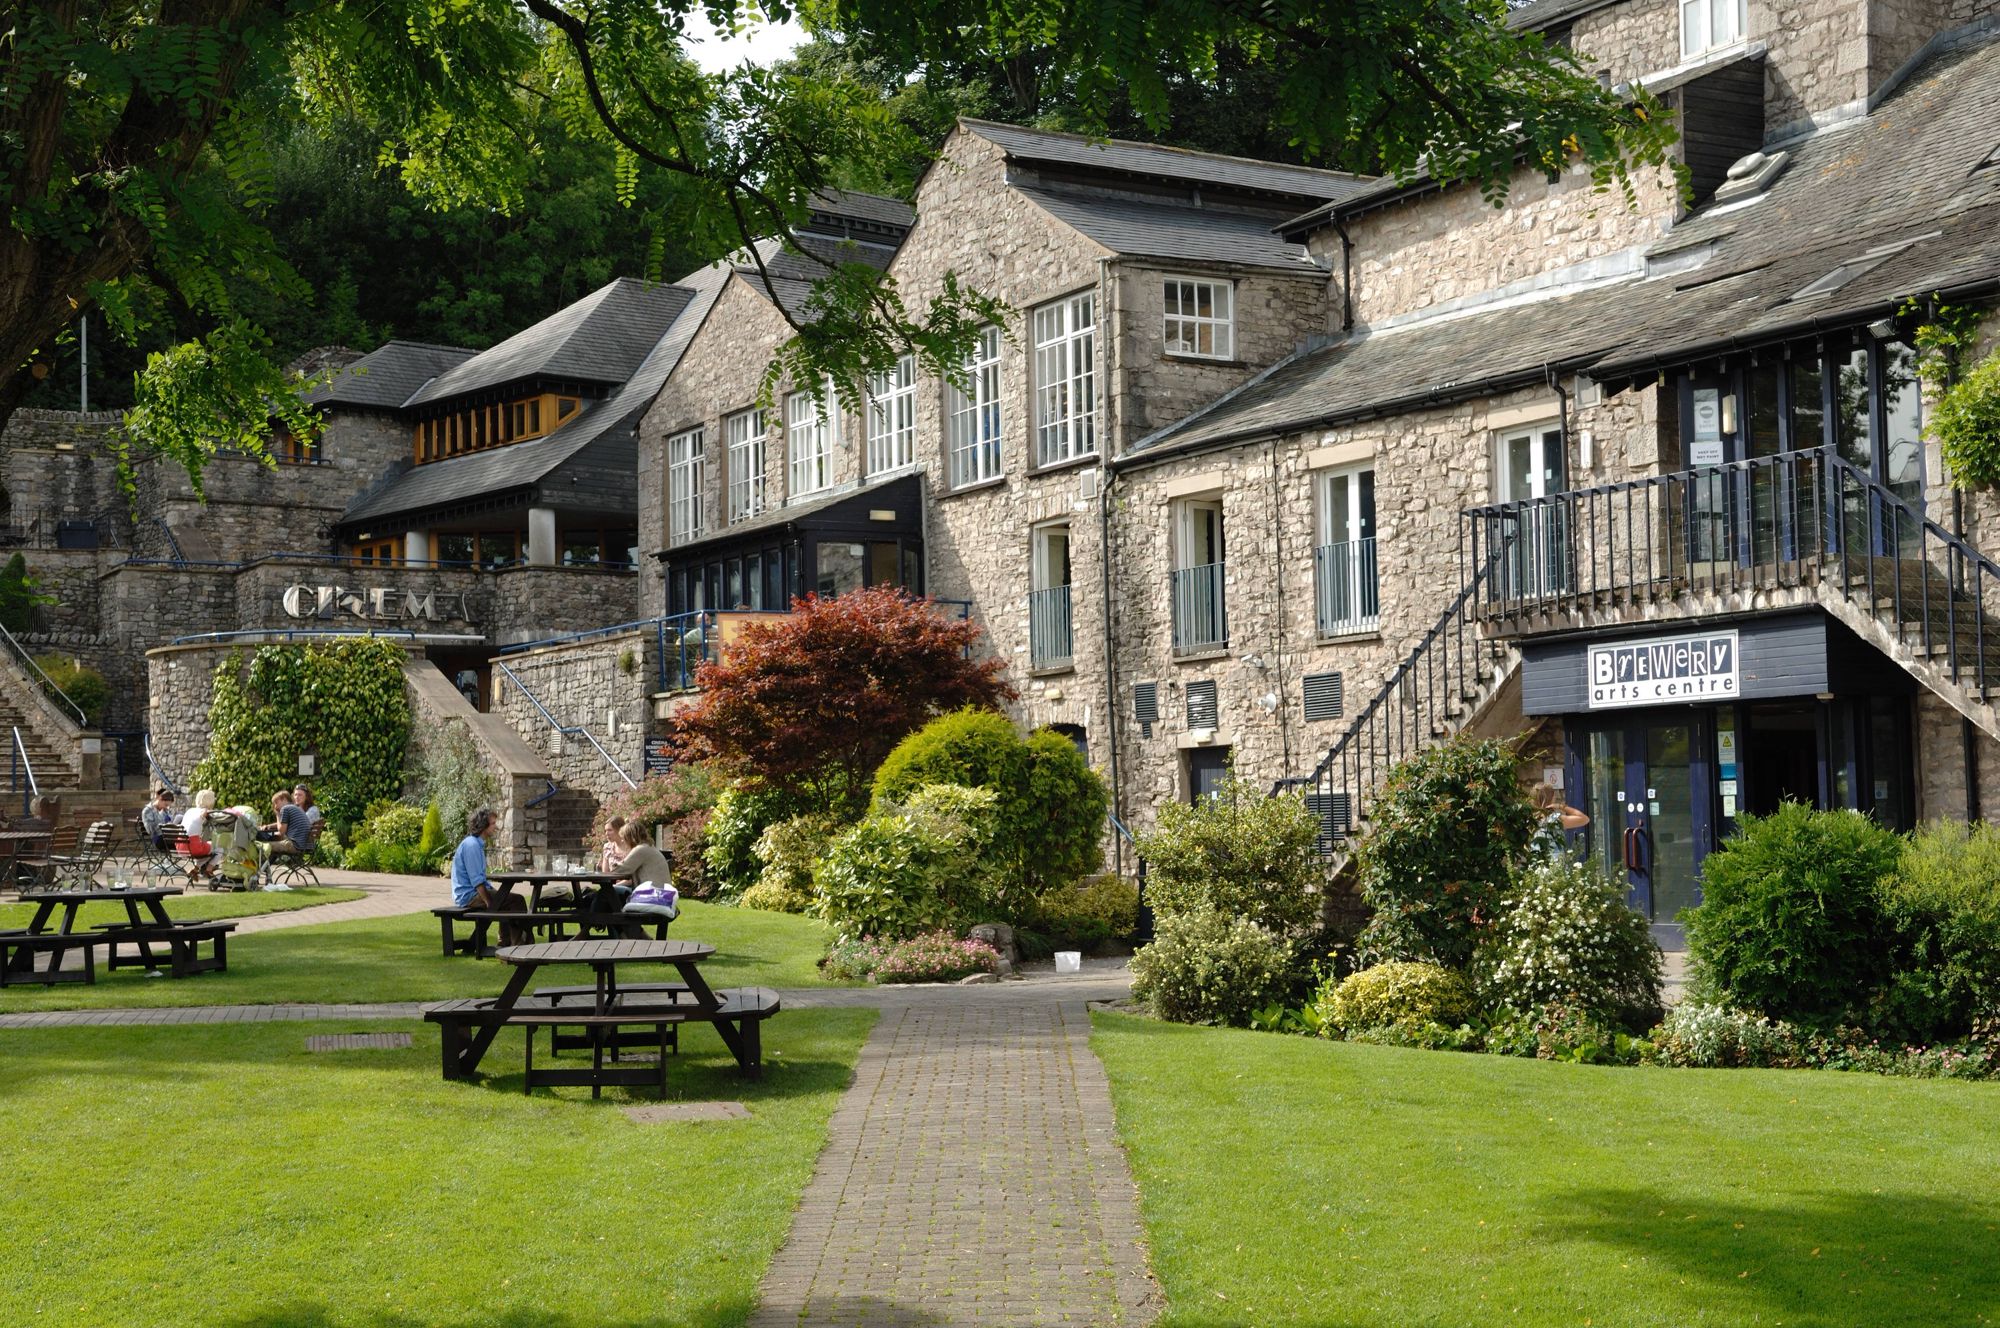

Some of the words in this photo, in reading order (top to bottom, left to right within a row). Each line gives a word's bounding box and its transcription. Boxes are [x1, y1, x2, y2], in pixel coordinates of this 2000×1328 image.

[283, 585, 475, 621] CINEMA
[1594, 684, 1639, 701] arts
[1655, 678, 1733, 697] centre
